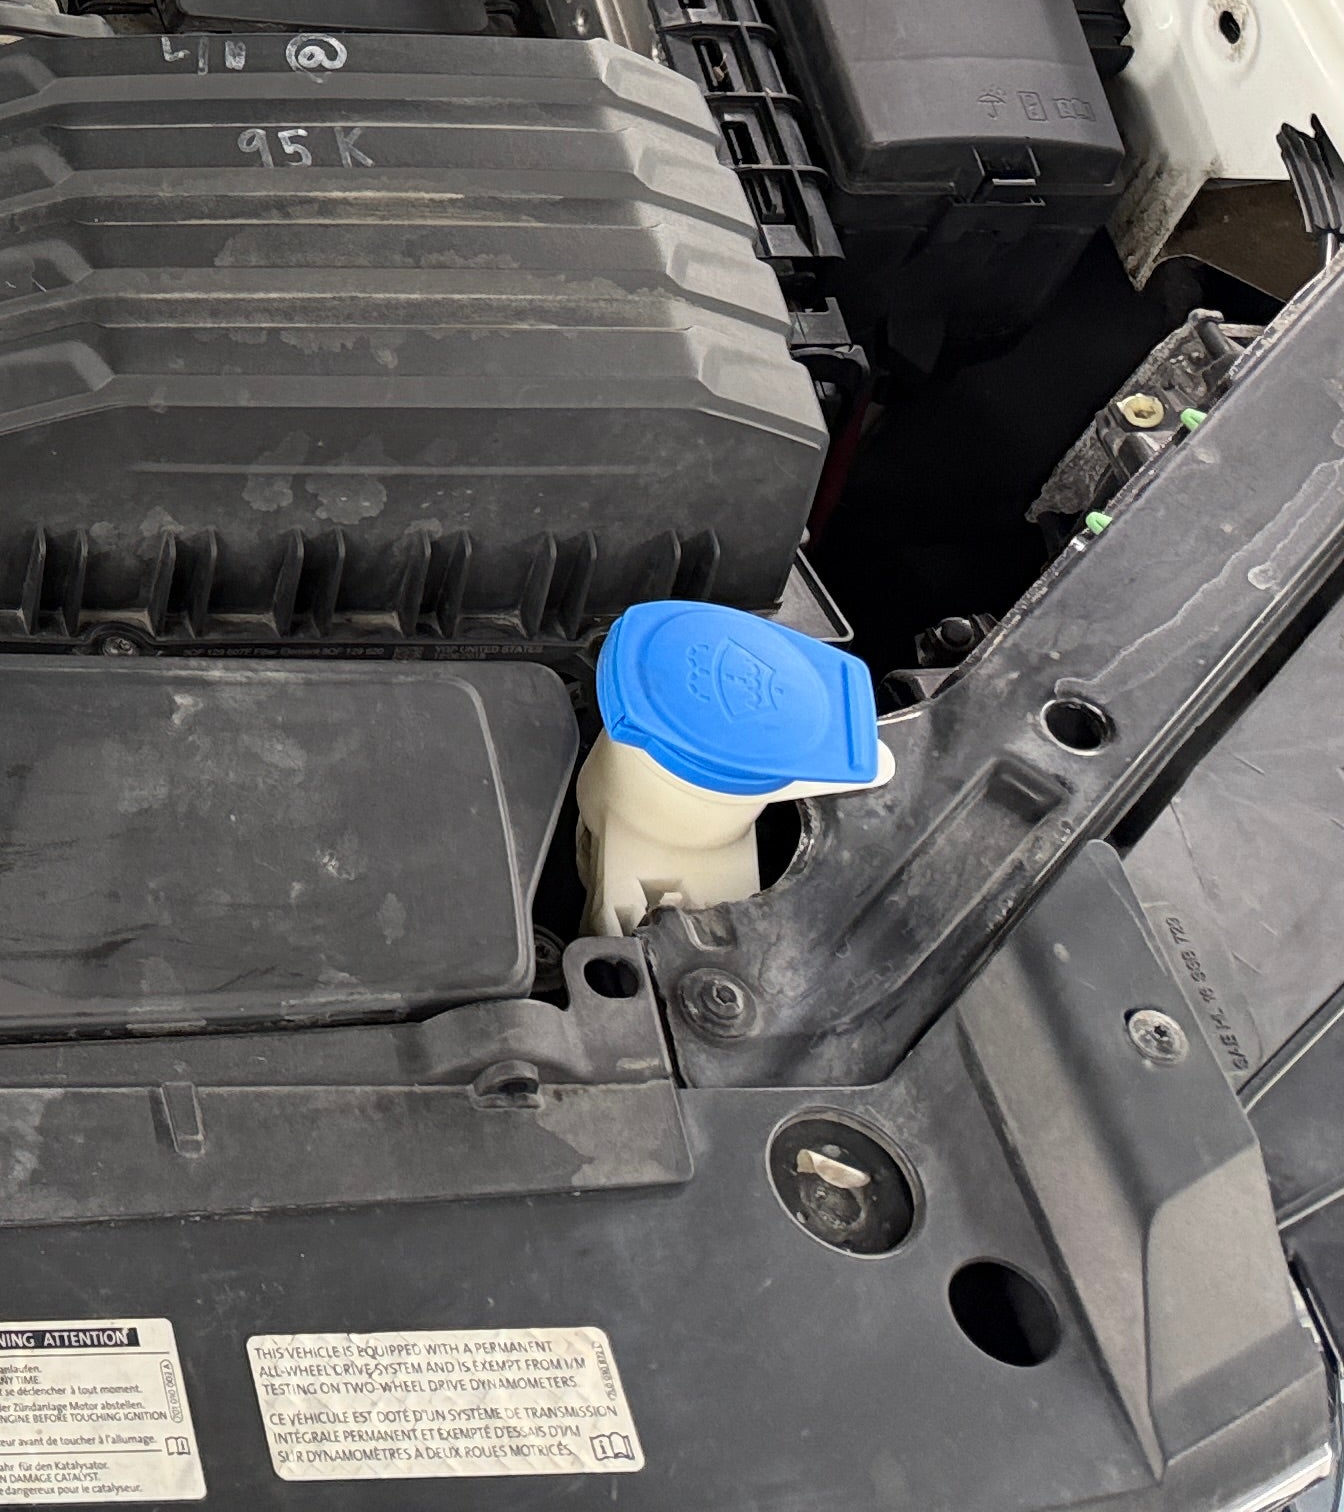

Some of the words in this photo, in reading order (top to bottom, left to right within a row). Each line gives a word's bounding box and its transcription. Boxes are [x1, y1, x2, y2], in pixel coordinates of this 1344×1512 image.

[42, 1330, 129, 1347] ATTENTION
[253, 1347, 285, 1360] THIS
[286, 1346, 339, 1360] VEHICLE
[357, 1343, 421, 1359] EQUIPPED
[424, 1342, 459, 1355] WITH
[474, 1340, 553, 1354] PERMANENT
[259, 1364, 332, 1378] ALL-WHEEL
[333, 1363, 372, 1377] DRIVE
[373, 1362, 422, 1376] SYSTEM
[426, 1361, 455, 1374] AND
[472, 1359, 521, 1373] EXEMPT
[524, 1358, 562, 1371] FROM
[78, 1384, 98, 1395] tout
[261, 1382, 317, 1396] TESTING
[319, 1382, 342, 1394] ON
[343, 1380, 426, 1394] TWO-WHEEL
[428, 1379, 466, 1392] DRIVE
[69, 1400, 99, 1411] Motor
[33, 1413, 69, 1424] BEFORE
[71, 1412, 122, 1423] TOUCHING
[123, 1410, 168, 1421] IGNITION
[269, 1413, 286, 1426] CE
[353, 1410, 373, 1423] EST
[505, 1408, 523, 1419] DE
[524, 1405, 618, 1419] TRANSMISSION
[18, 1436, 44, 1447] avant
[59, 1434, 96, 1446] toucher
[342, 1428, 419, 1443] PERMANENT
[277, 1450, 306, 1463] SUR
[426, 1446, 462, 1460] DEUX
[465, 1445, 508, 1459] ROUES
[35, 1461, 52, 1472] den
[9, 1472, 52, 1484] DAMAGE
[5, 1485, 55, 1498] dangereux
[57, 1485, 79, 1496] pour
